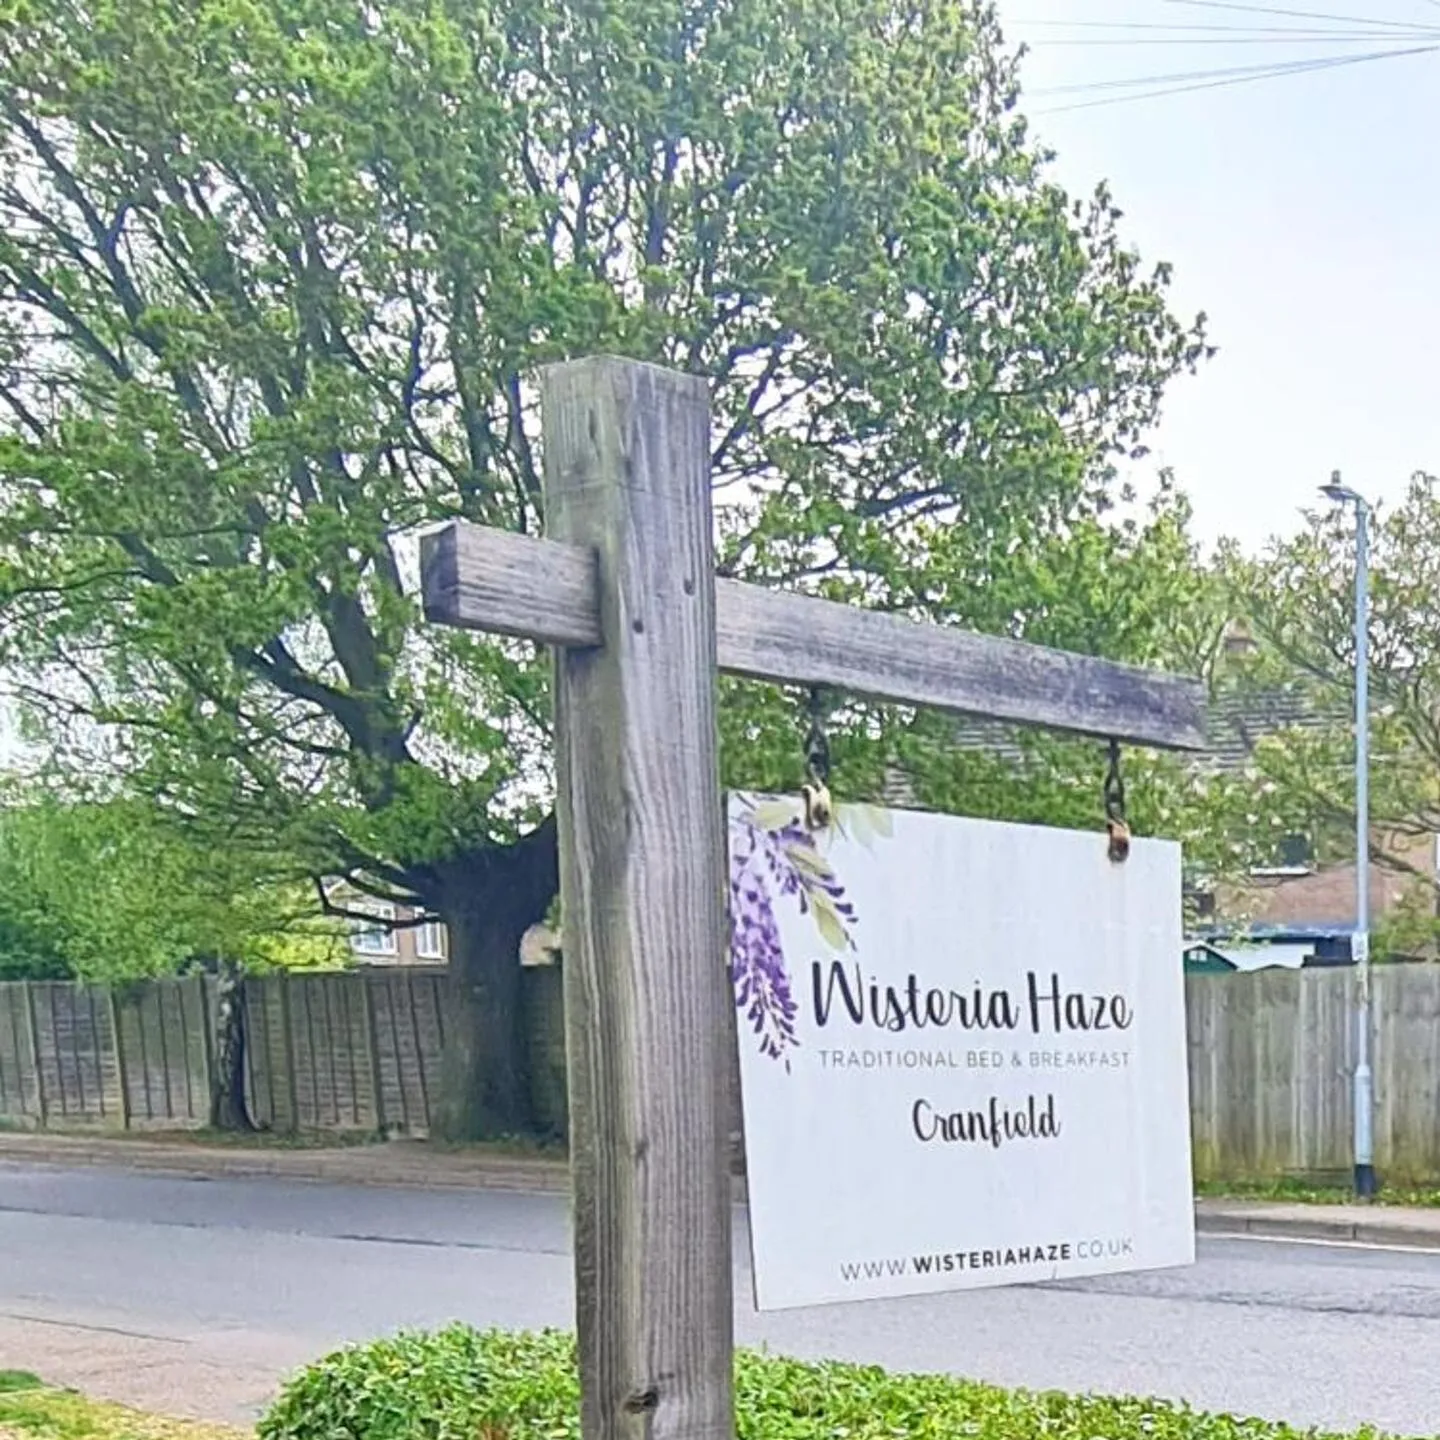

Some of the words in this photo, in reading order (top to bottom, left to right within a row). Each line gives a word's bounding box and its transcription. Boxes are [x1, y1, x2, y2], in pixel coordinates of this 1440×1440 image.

[812, 960, 1019, 1032] Wisteria
[1028, 971, 1133, 1034] Haze
[818, 1050, 959, 1068] TRADITIONAL
[967, 1050, 1004, 1068] BED
[1010, 1051, 1022, 1067] &
[1029, 1050, 1131, 1068] BREAKFAST
[912, 1094, 1061, 1148] Cranfield
